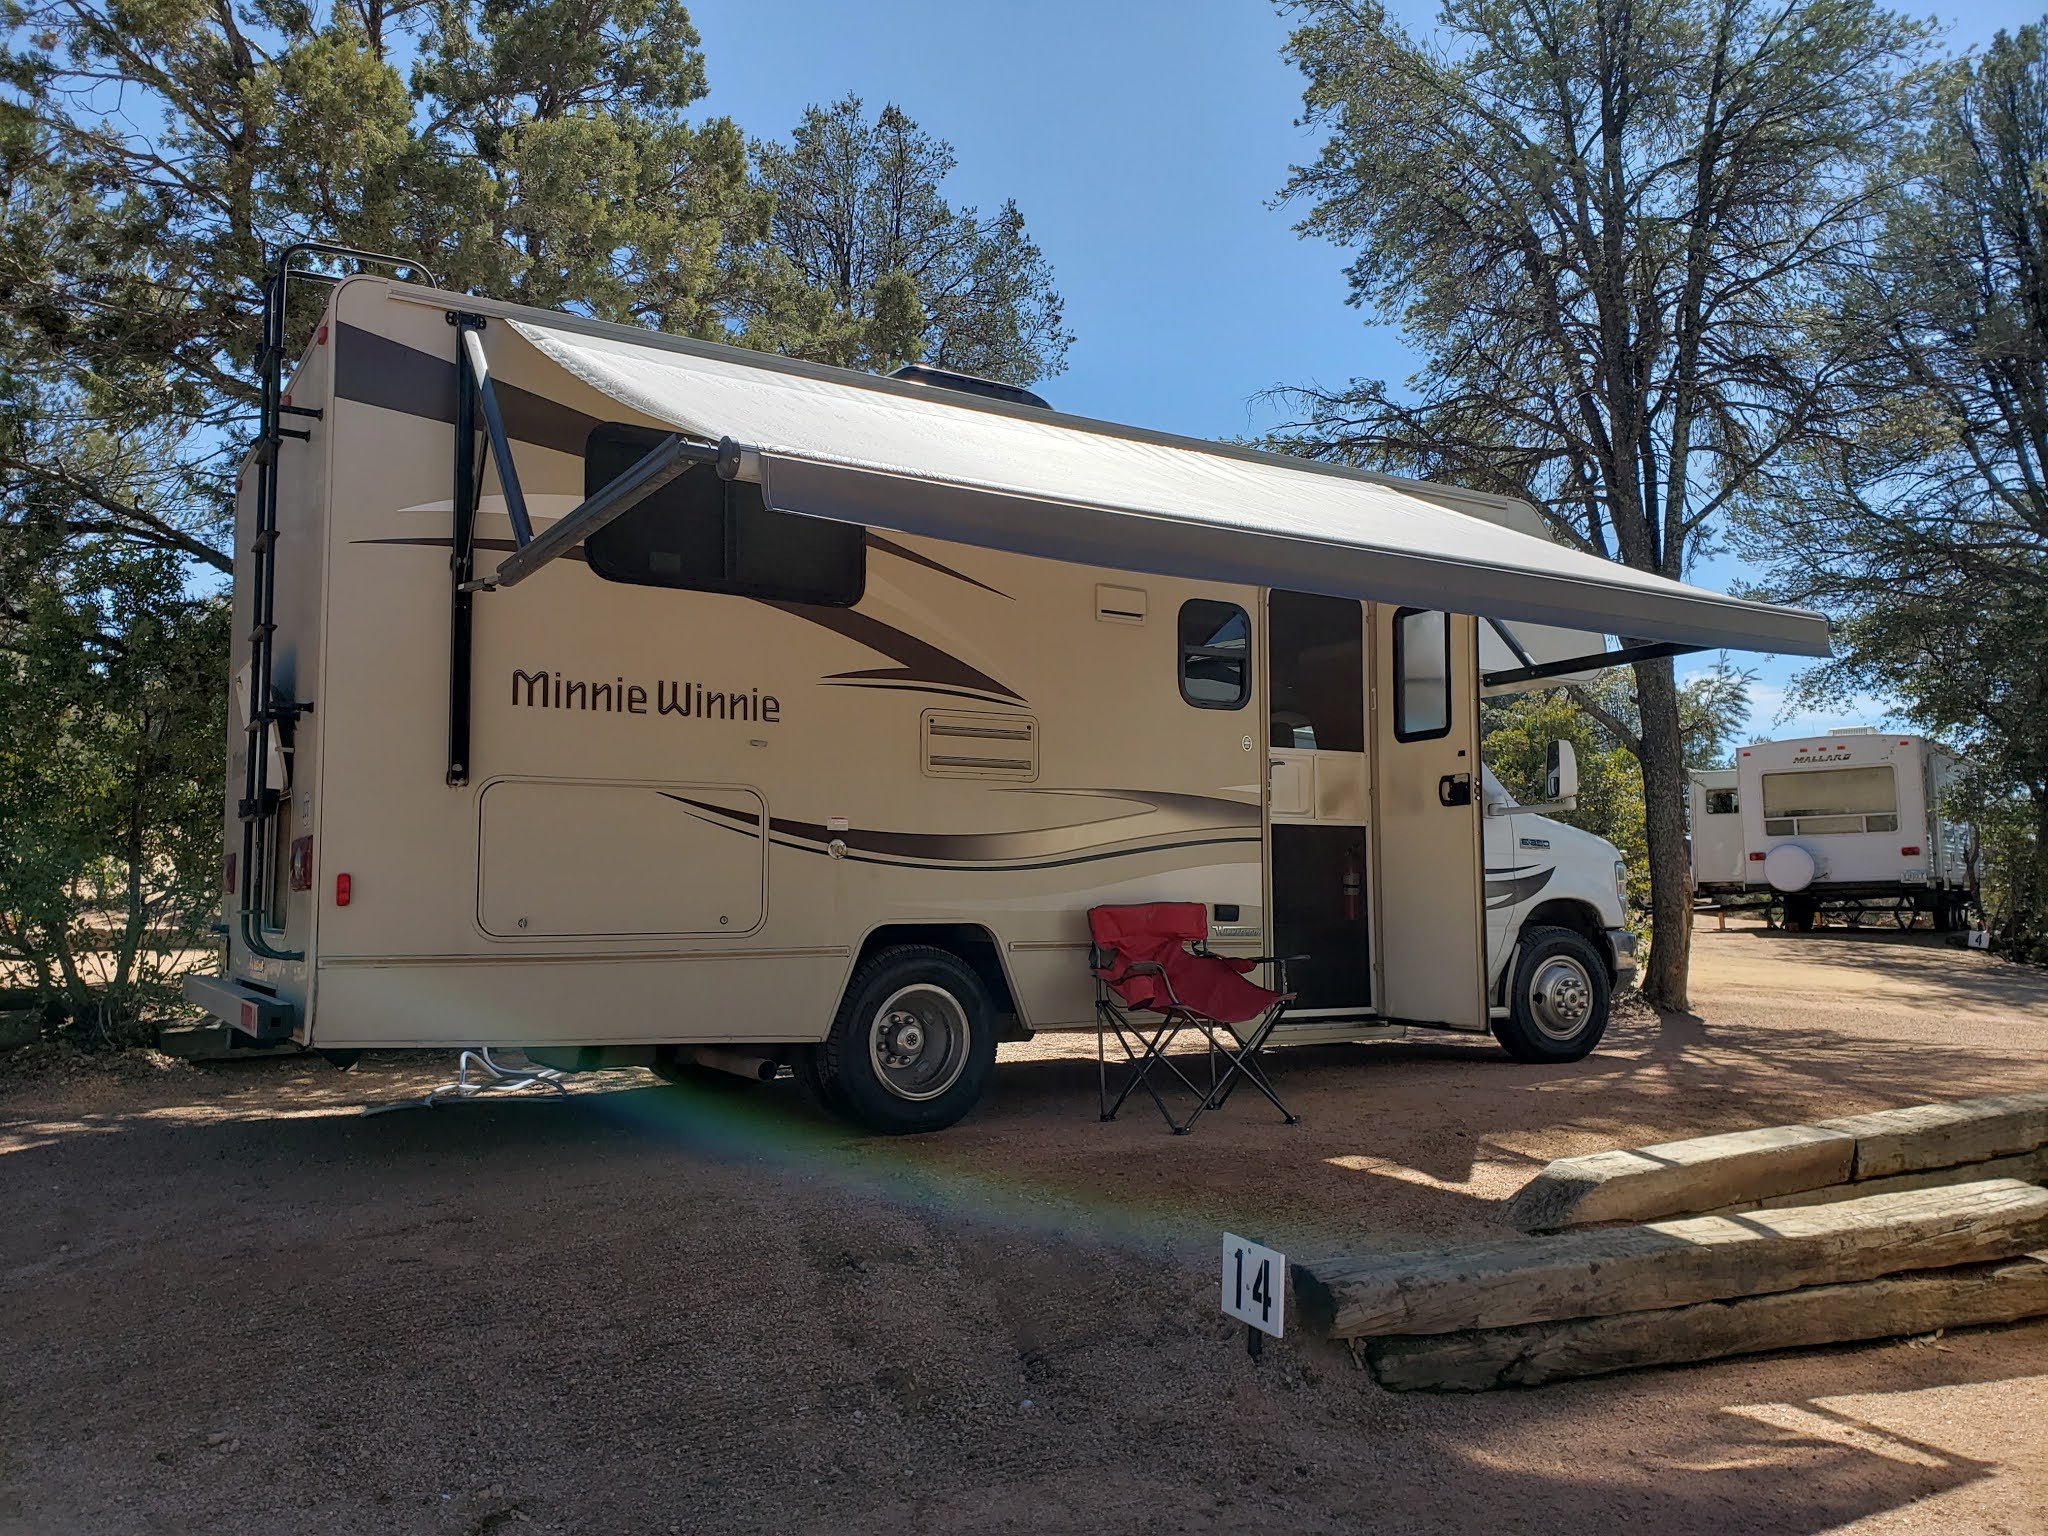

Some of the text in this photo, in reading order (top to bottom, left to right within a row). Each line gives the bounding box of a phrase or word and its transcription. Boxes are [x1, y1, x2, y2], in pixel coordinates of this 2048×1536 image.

[511, 668, 780, 723] Minnie Winnie
[1792, 753, 1852, 764] MALLARD
[1975, 933, 1983, 947] 4
[1235, 1248, 1271, 1323] 14
